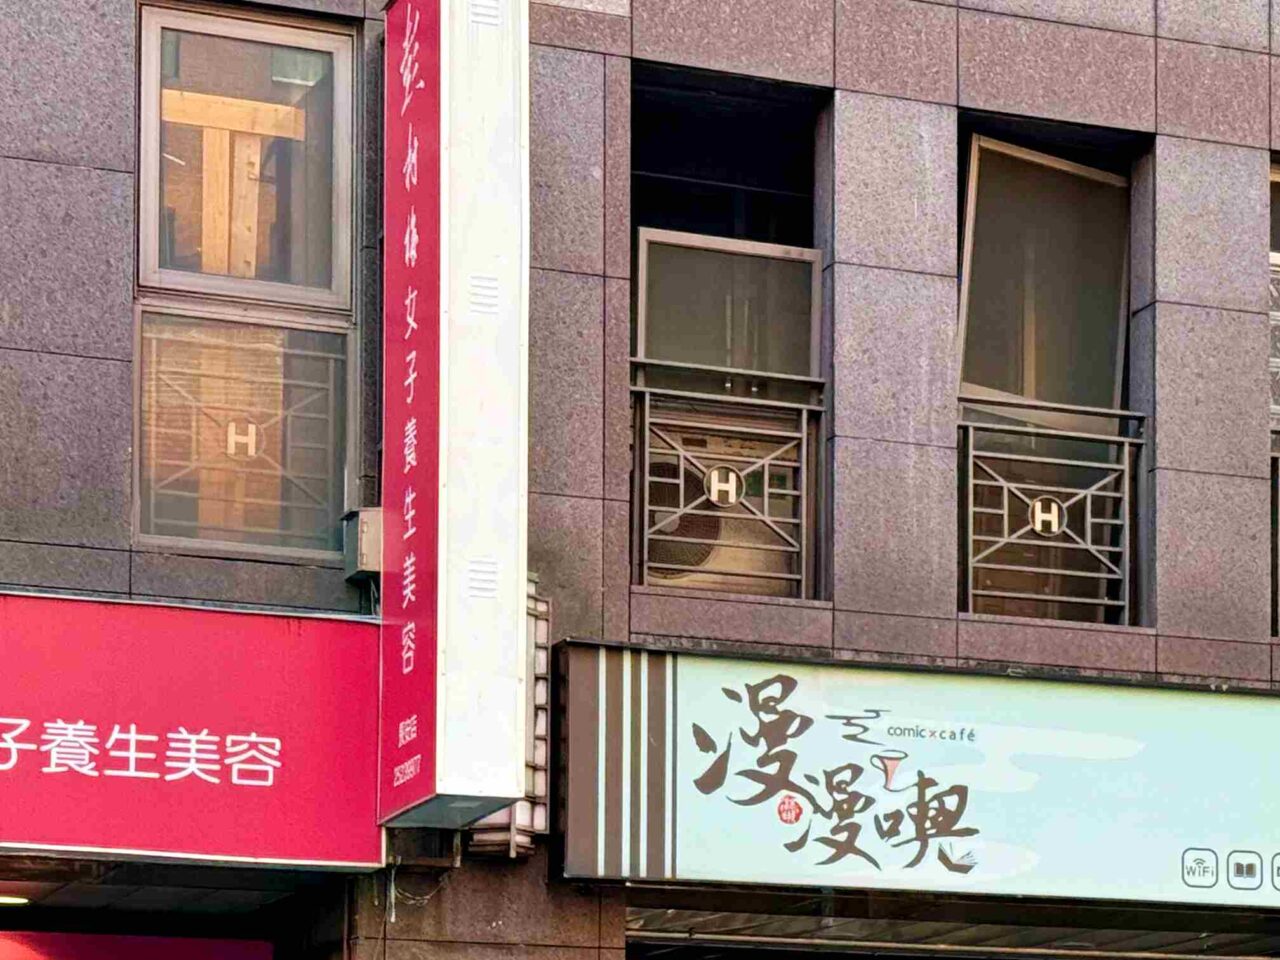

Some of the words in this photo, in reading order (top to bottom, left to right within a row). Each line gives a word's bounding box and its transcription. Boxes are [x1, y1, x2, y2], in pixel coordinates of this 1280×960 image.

[0, 717, 282, 788] 子養生美容
